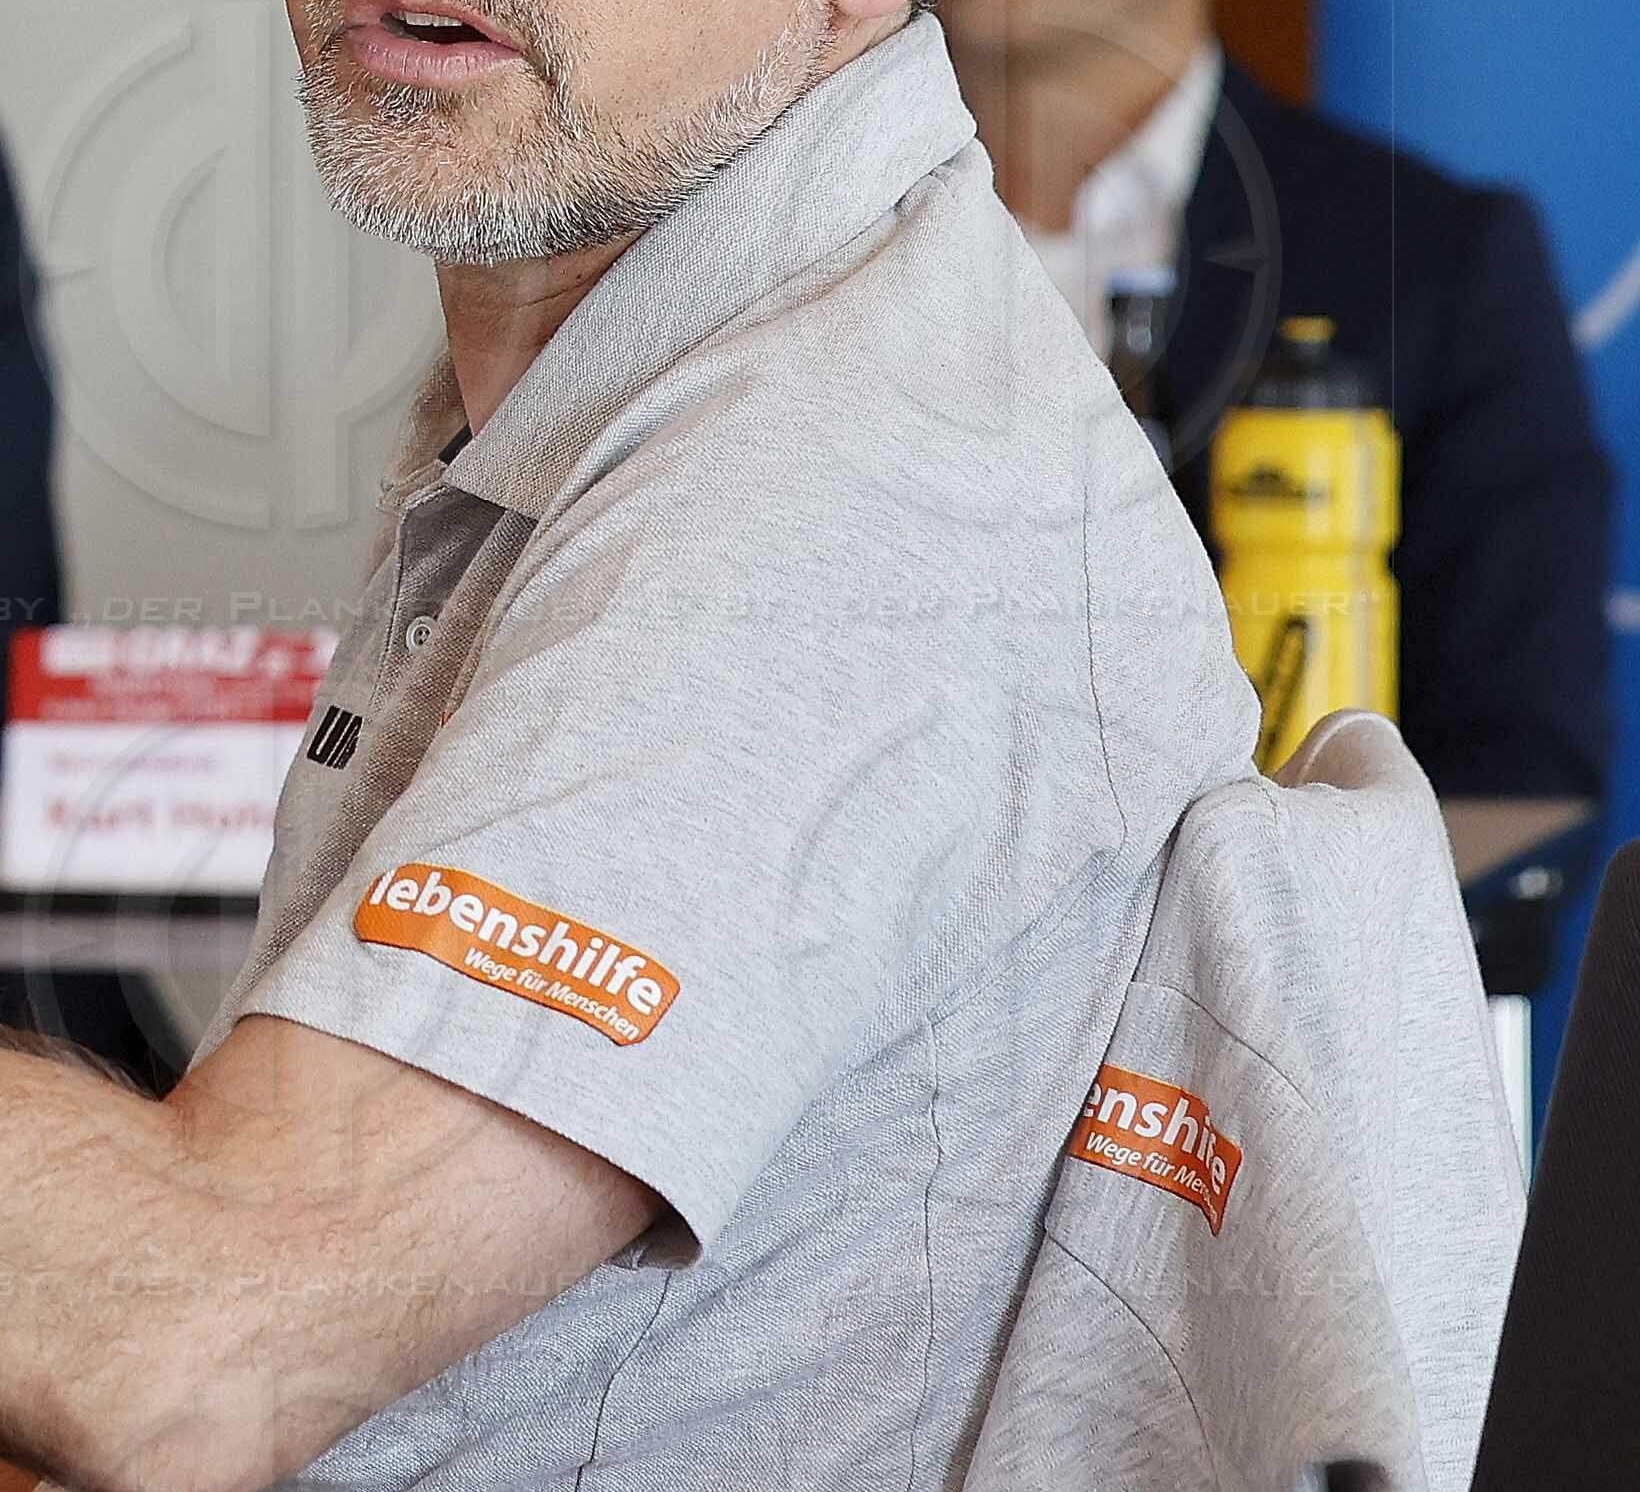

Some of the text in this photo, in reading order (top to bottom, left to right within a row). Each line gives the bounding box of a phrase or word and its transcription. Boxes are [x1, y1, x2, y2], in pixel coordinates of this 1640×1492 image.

[370, 868, 663, 1015] lebenshilfe
[463, 947, 640, 1041] Wege für Menschen
[1086, 1131, 1142, 1168] Wege
[1141, 1152, 1176, 1178] für
